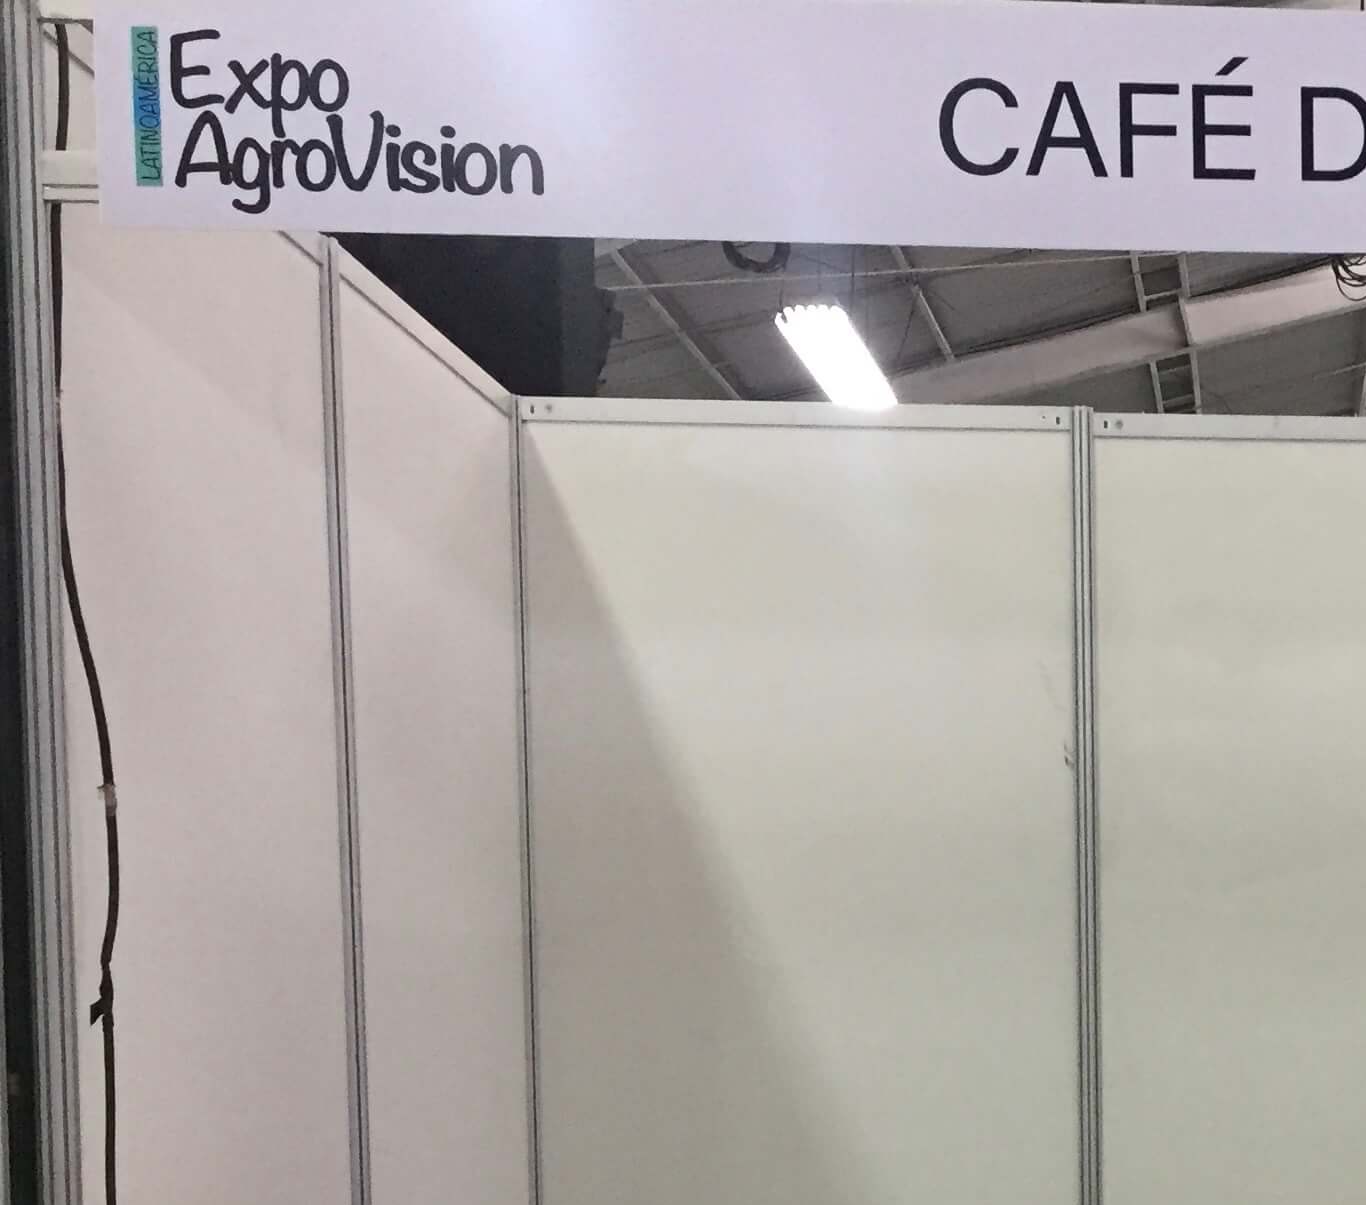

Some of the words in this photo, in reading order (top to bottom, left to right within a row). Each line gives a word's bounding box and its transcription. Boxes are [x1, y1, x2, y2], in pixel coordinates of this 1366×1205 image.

[170, 29, 350, 138] Expo
[939, 57, 1256, 180] CAFÉ
[174, 110, 545, 214] AgroVision
